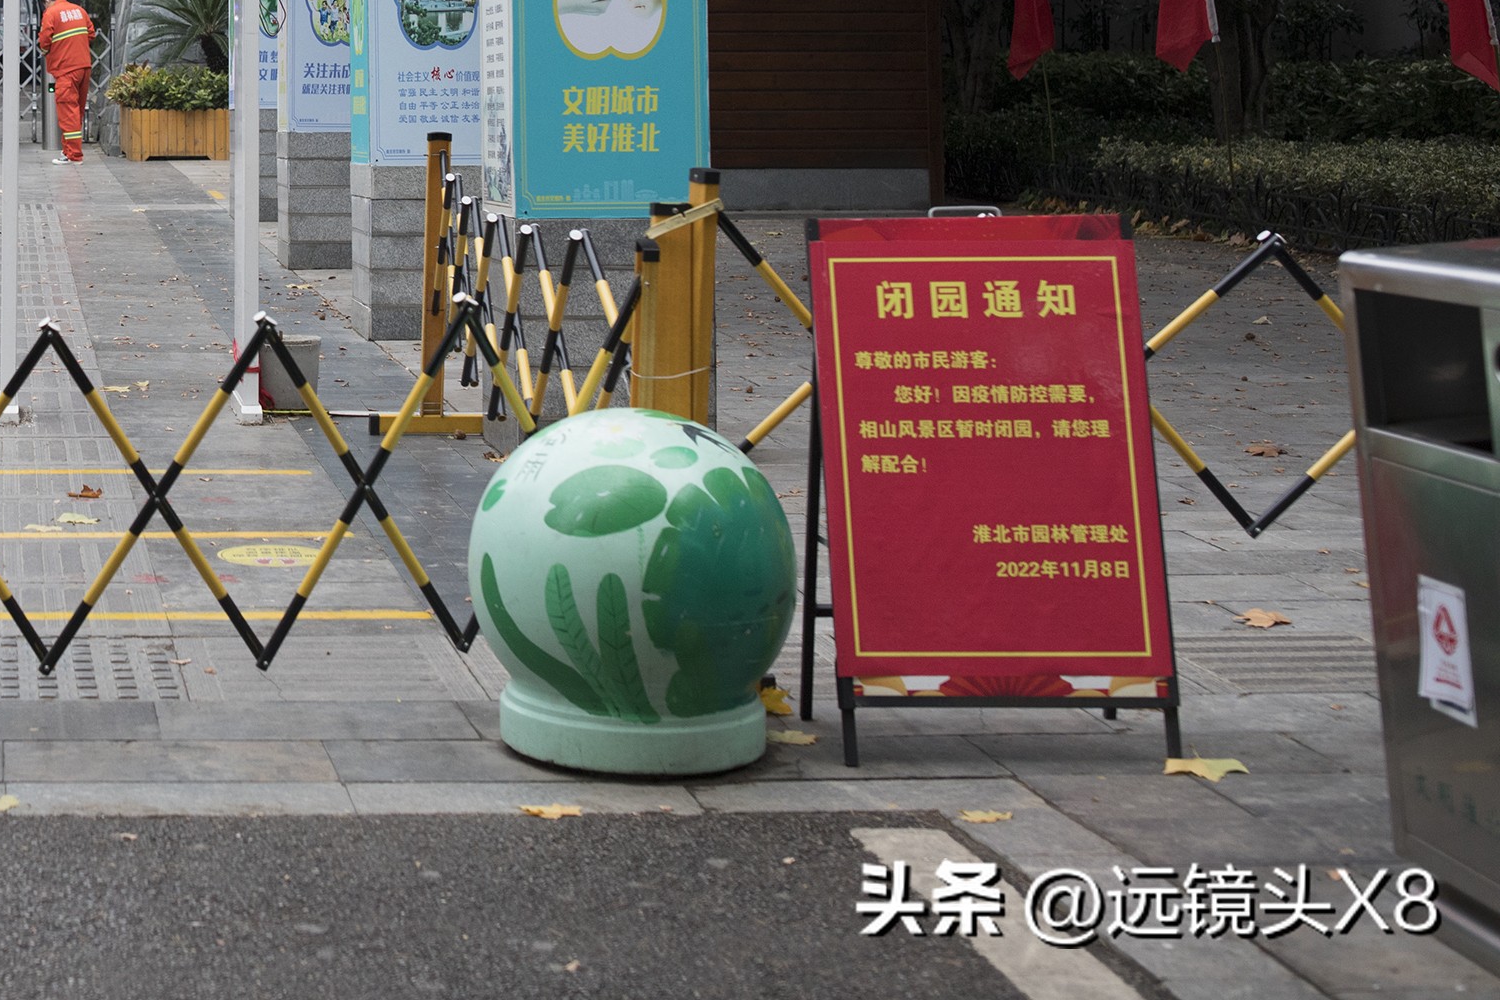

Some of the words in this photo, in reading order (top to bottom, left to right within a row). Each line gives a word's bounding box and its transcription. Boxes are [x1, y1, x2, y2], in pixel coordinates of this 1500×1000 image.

[562, 85, 659, 116] 文明城市
[562, 123, 660, 153] 美好淮北
[875, 279, 1077, 319] 闭园通知
[972, 523, 1129, 544] 淮北市园林管理处
[996, 559, 1130, 580] 2022年11月8日
